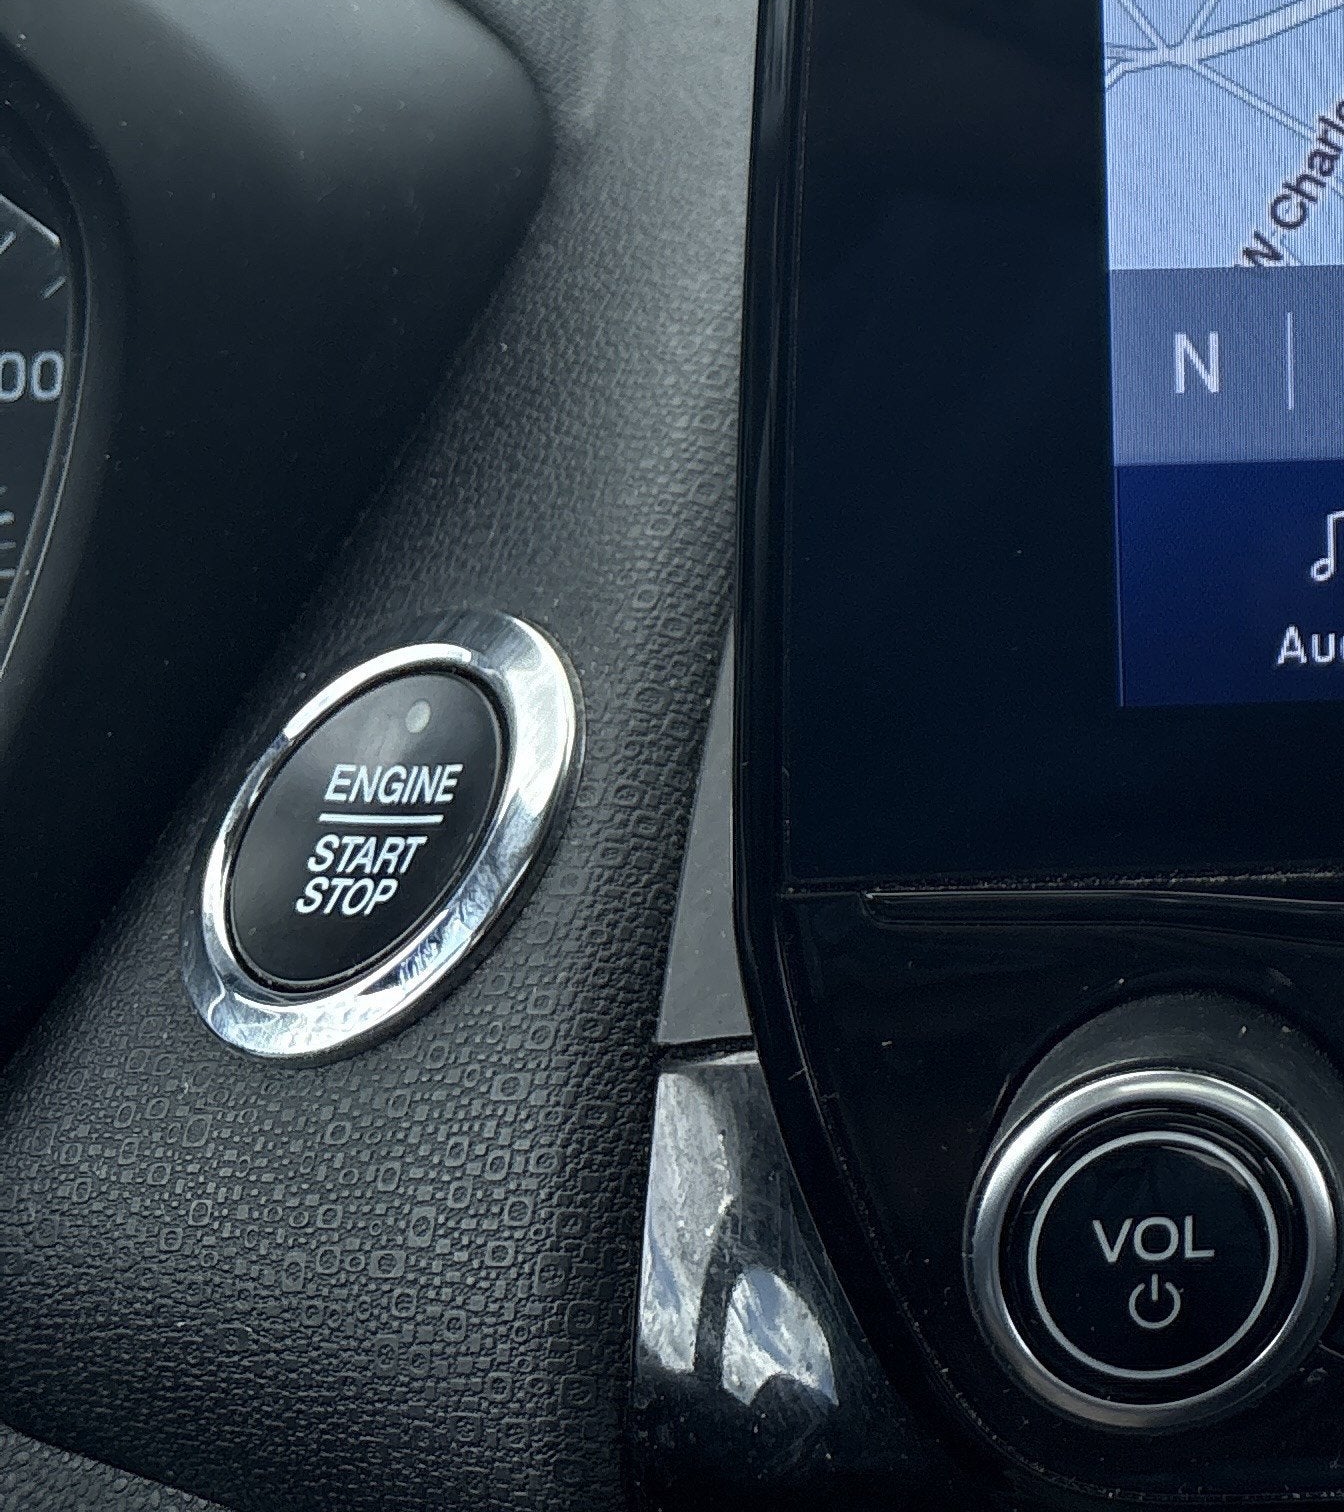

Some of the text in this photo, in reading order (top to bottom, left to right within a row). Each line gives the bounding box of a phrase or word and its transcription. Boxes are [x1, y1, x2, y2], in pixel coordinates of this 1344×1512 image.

[1173, 331, 1221, 395] N
[323, 763, 464, 805] ENGINE
[306, 833, 428, 874] START
[295, 875, 400, 917] STOP
[1090, 1215, 1216, 1264] VOL
